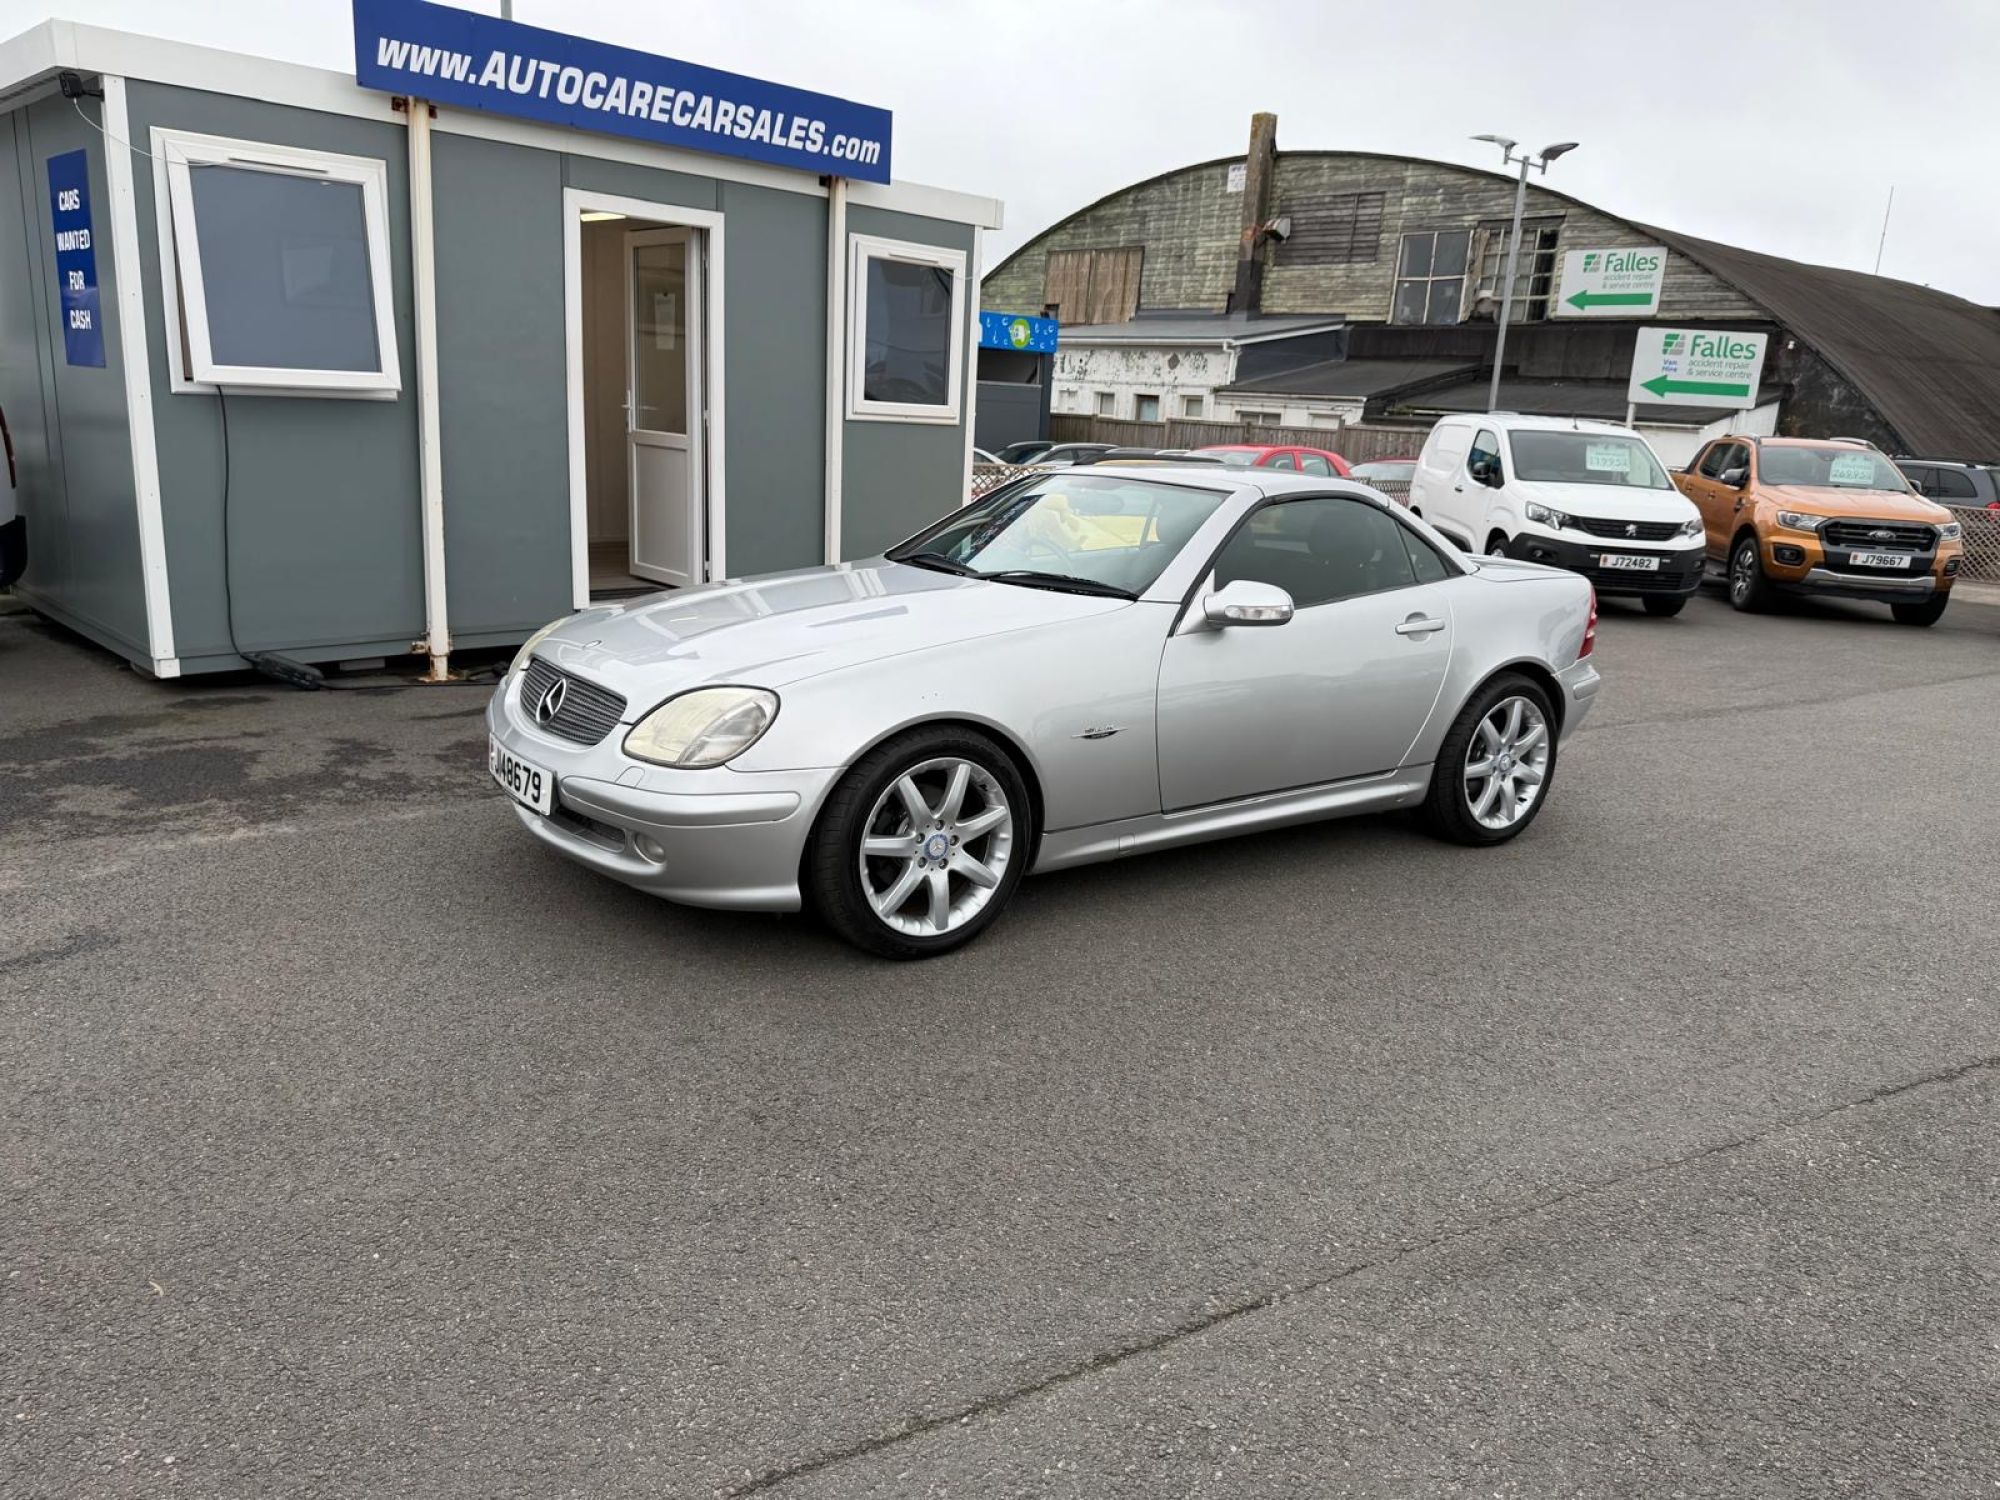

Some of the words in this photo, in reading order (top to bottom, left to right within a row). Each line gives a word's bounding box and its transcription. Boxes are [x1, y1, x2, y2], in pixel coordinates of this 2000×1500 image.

[376, 37, 880, 165] www.AUTOCARECARSALES.com
[58, 189, 80, 211] CARS
[57, 229, 91, 251] WANTED
[1604, 251, 1659, 272] Falles
[68, 270, 85, 290] FOR
[1602, 273, 1631, 281] accident
[70, 309, 92, 329] CASH
[1689, 334, 1757, 360] Falles
[1686, 368, 1693, 376] &
[1723, 371, 1752, 380] centre
[1688, 359, 1723, 369] accident
[1724, 362, 1751, 372] repair
[1612, 556, 1652, 568] J72482
[1862, 554, 1904, 566] J79667
[495, 747, 541, 804] J48679
